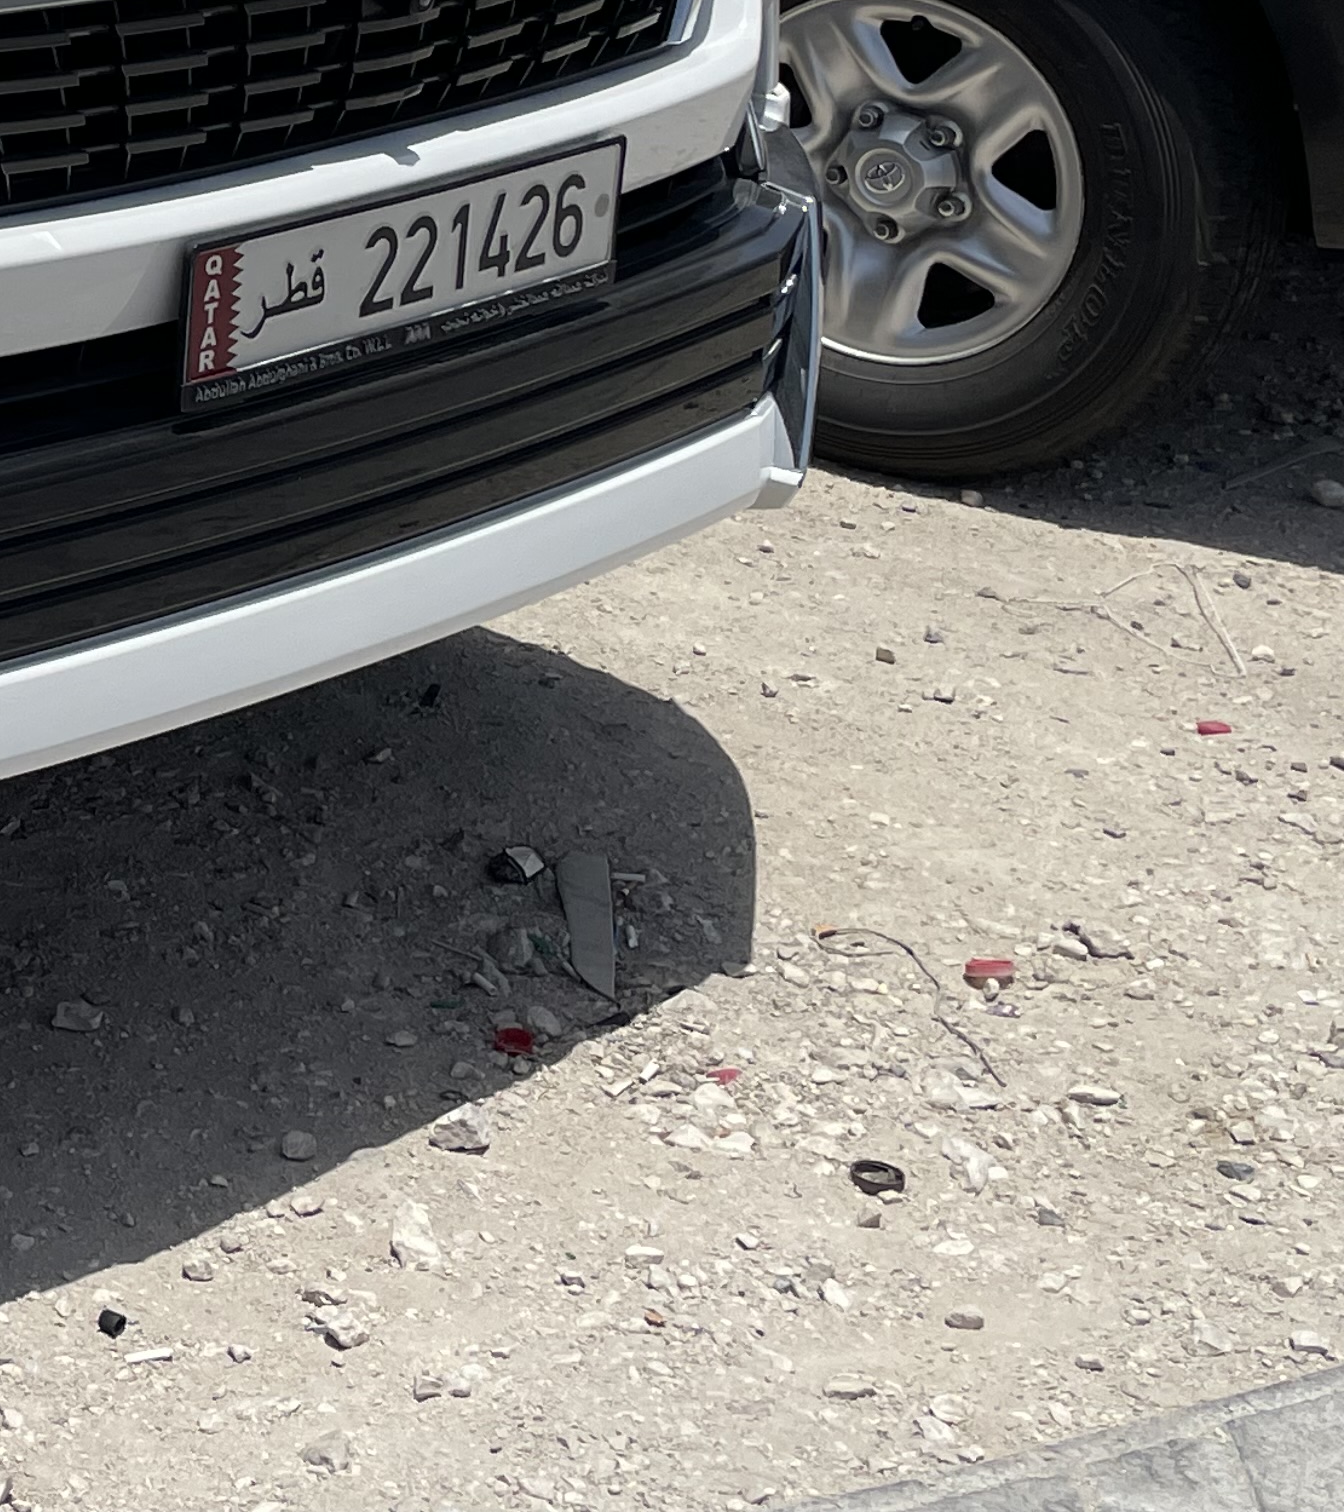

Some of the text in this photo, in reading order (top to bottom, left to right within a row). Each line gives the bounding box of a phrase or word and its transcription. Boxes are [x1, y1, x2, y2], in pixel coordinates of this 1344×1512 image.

[240, 248, 326, 339] قطر
[358, 172, 587, 319] 221426
[198, 254, 223, 373] QATAR
